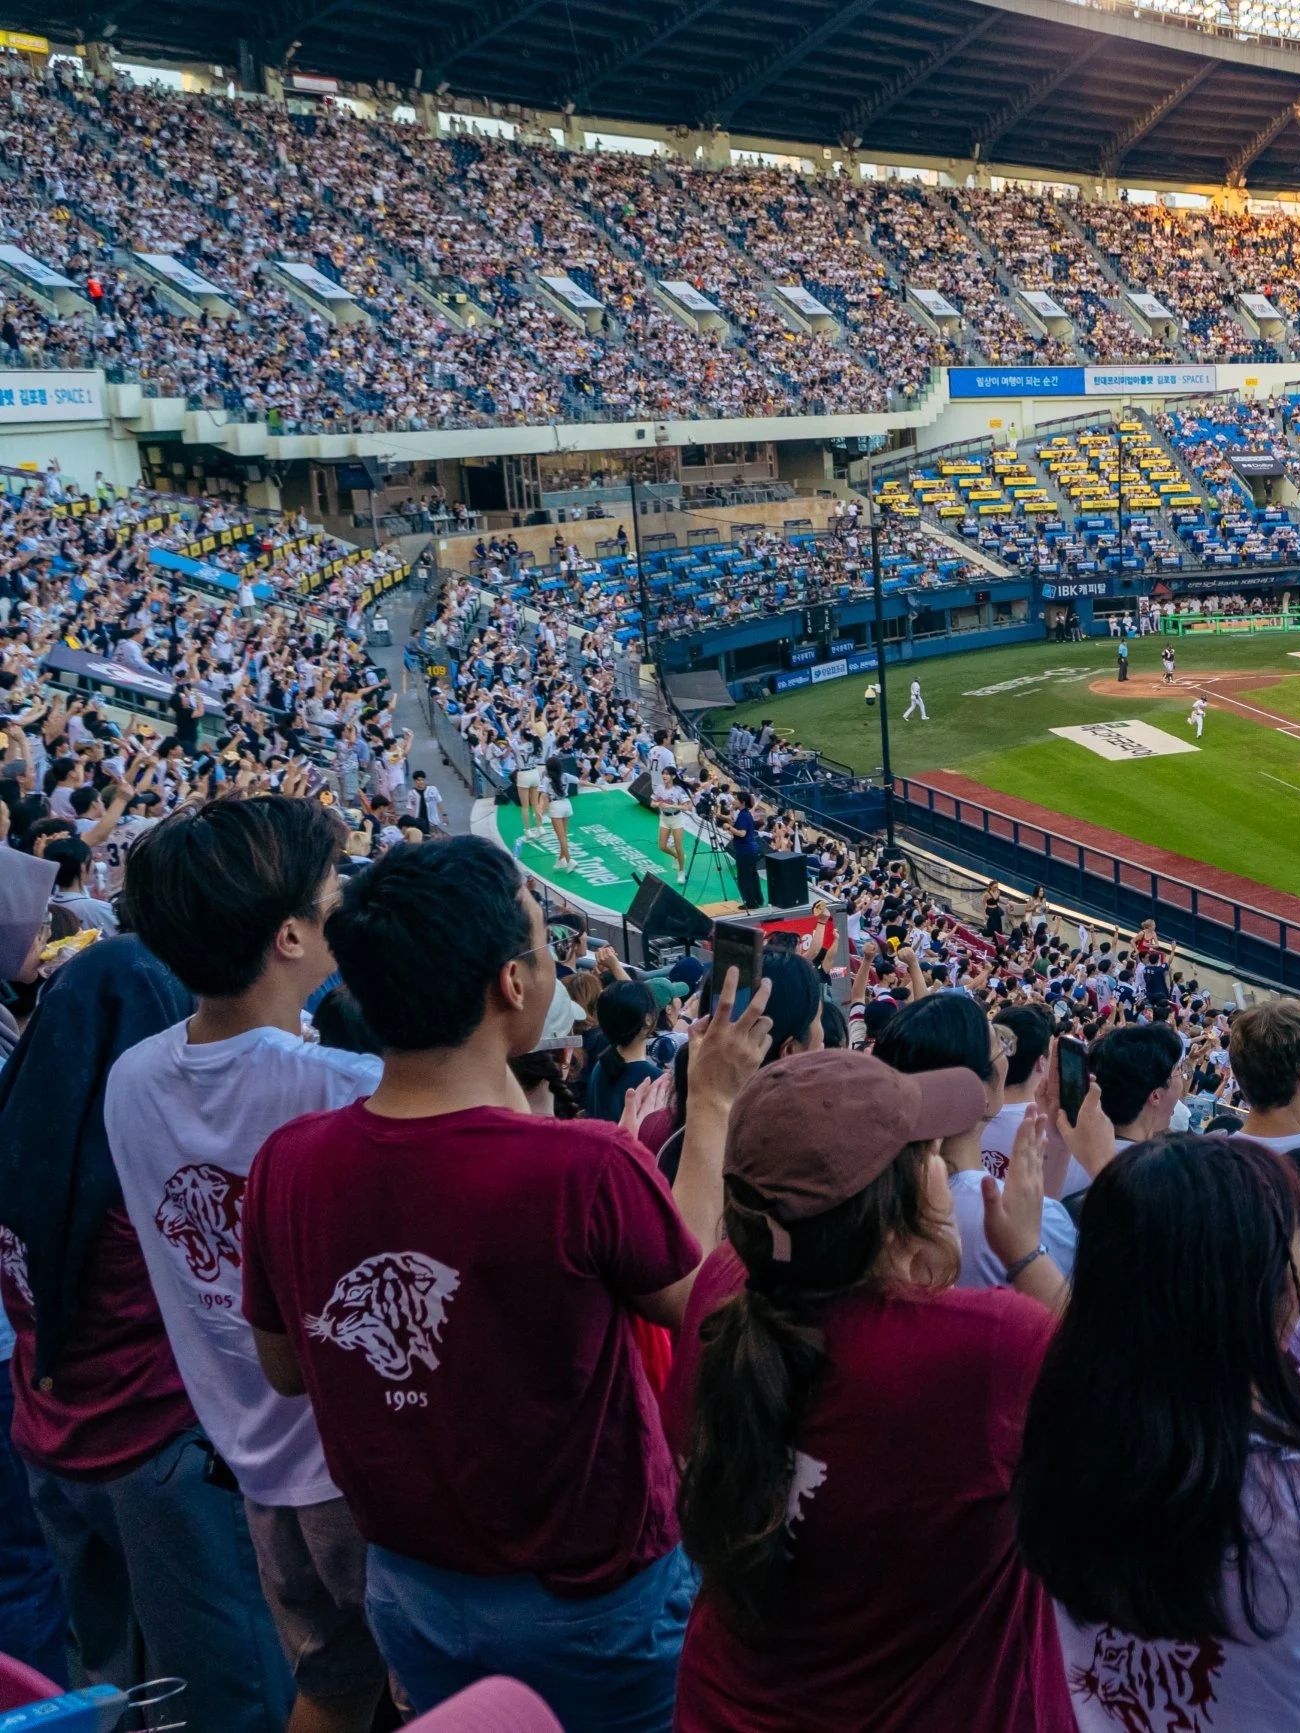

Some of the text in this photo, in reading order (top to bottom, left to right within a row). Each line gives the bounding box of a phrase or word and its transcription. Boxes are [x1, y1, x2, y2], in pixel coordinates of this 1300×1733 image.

[976, 375, 1059, 388] 일상이 여행이 되는 순간
[1157, 375, 1177, 385] 김포점
[1182, 375, 1204, 384] SPACE
[54, 387, 85, 405] SPACE
[86, 388, 94, 404] 1
[427, 665, 446, 677] 109
[574, 856, 634, 887] Travel
[198, 1294, 233, 1310] 1905
[385, 1390, 429, 1411] 1905
